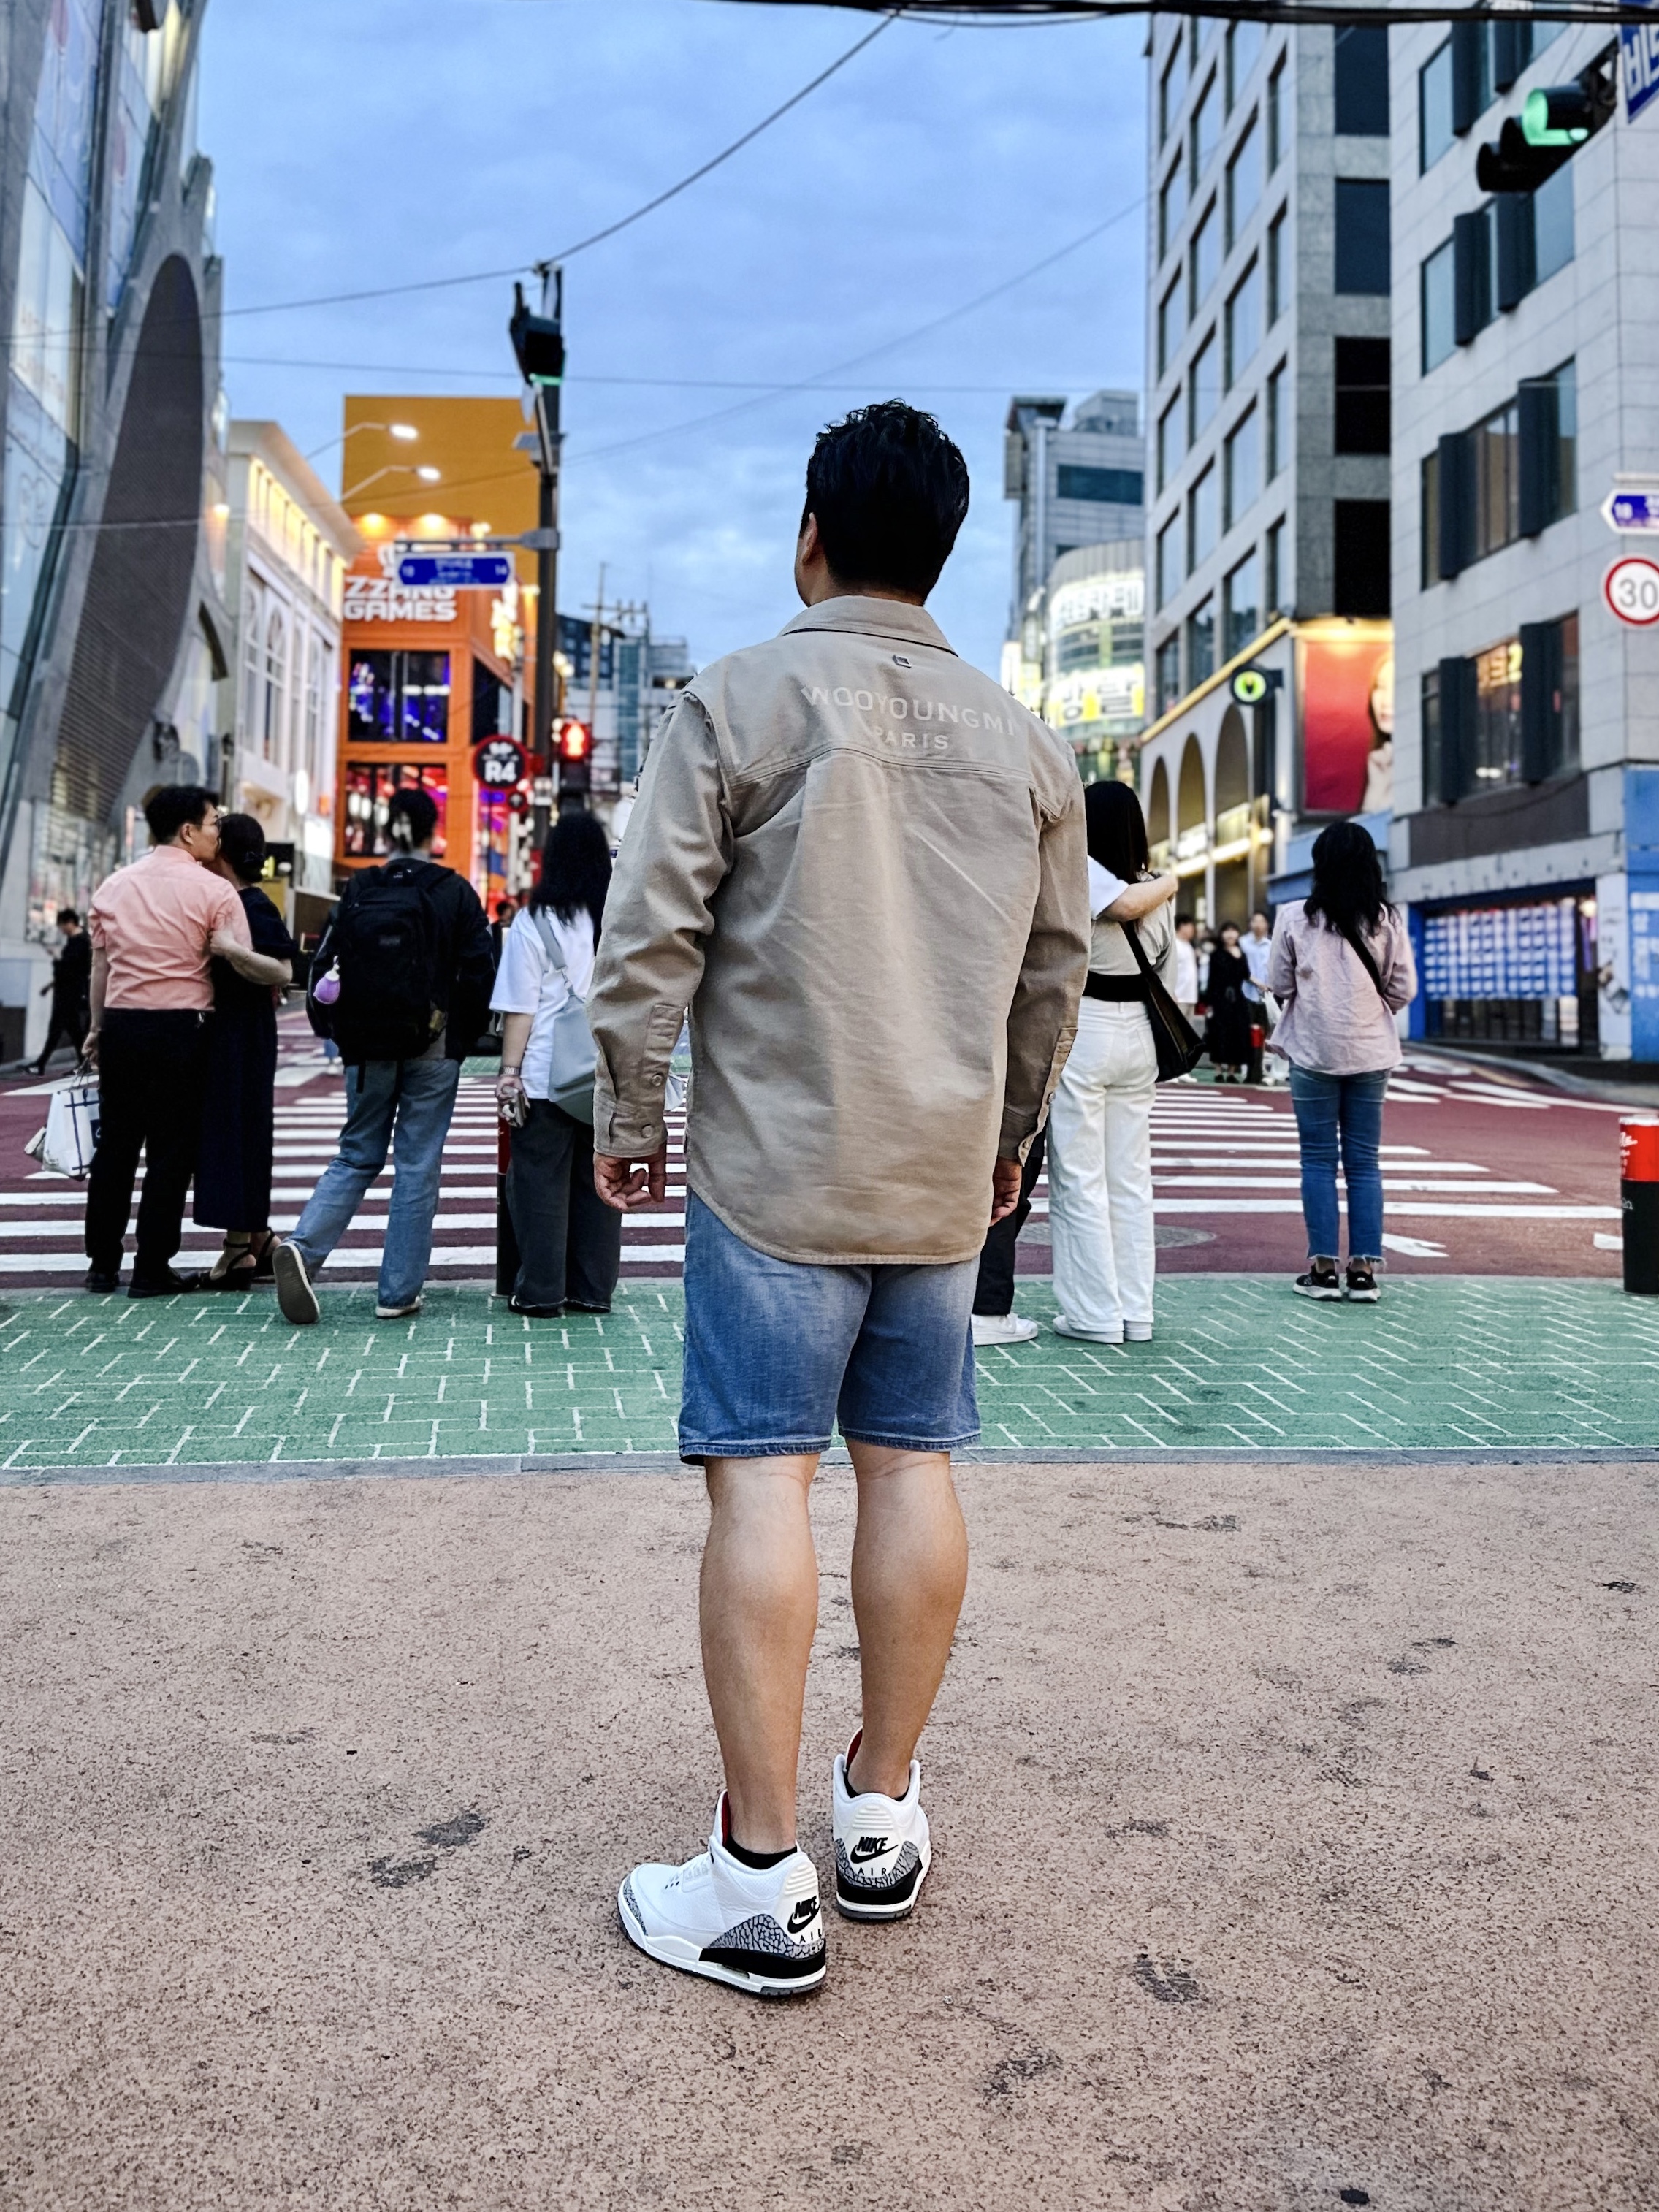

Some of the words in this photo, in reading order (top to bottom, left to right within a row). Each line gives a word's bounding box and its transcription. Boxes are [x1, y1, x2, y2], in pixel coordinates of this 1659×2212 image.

[1620, 578, 1658, 609] 30
[343, 600, 457, 621] GAMES
[801, 685, 1015, 736] WOOYOUNGMI
[875, 726, 949, 750] PARIS
[856, 1837, 888, 1851] NIKE
[858, 1867, 888, 1875] AIR
[793, 1896, 817, 1919] NIKE
[799, 1929, 822, 1944] AIR
